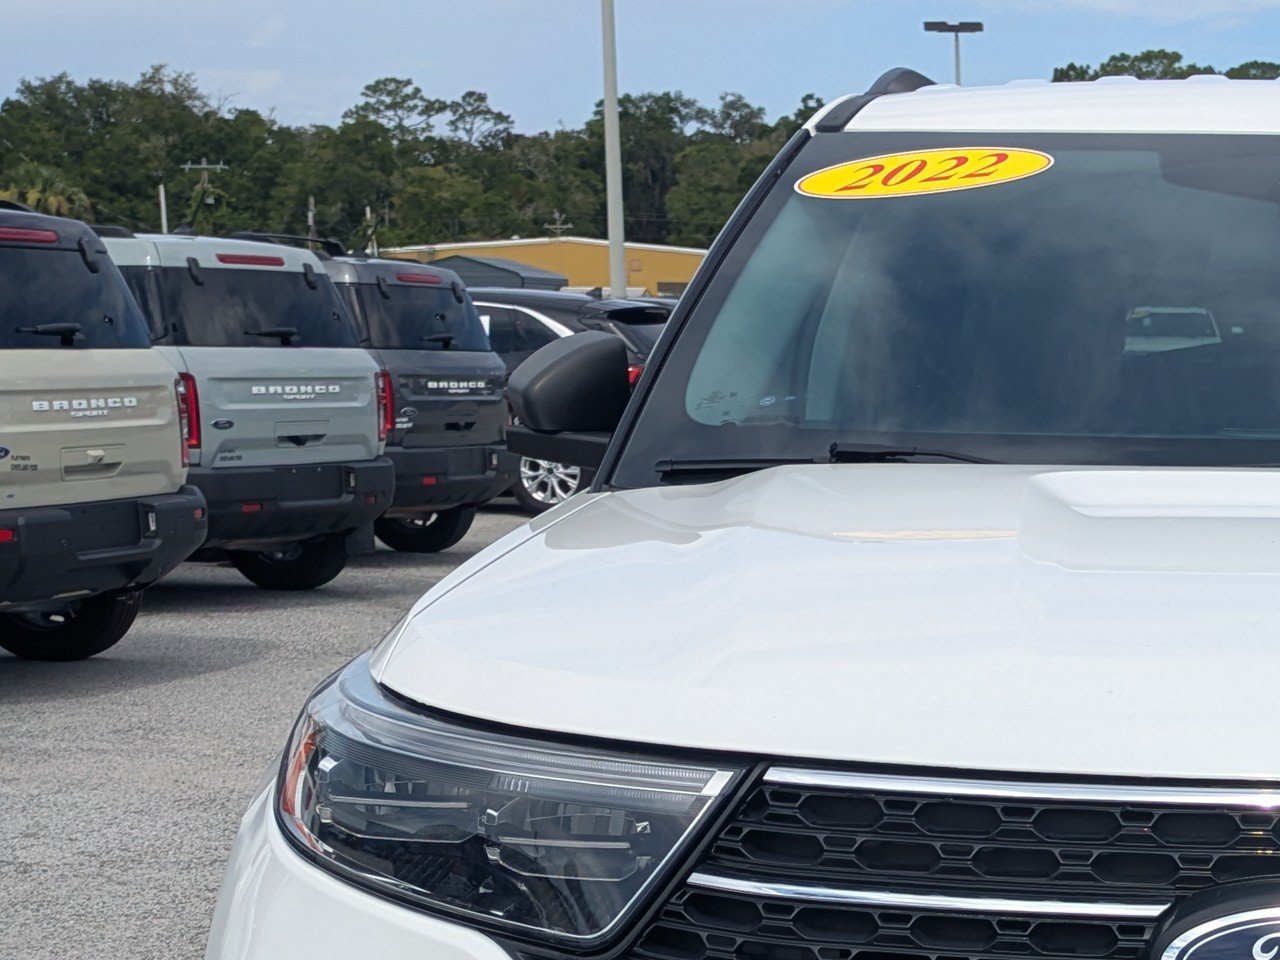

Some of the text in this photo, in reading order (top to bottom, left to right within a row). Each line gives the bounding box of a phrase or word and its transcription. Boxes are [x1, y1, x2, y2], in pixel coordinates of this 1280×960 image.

[833, 152, 1009, 193] 2022
[251, 385, 340, 394] BRONCO
[427, 381, 486, 389] BRONCO
[32, 397, 138, 411] BRONCO
